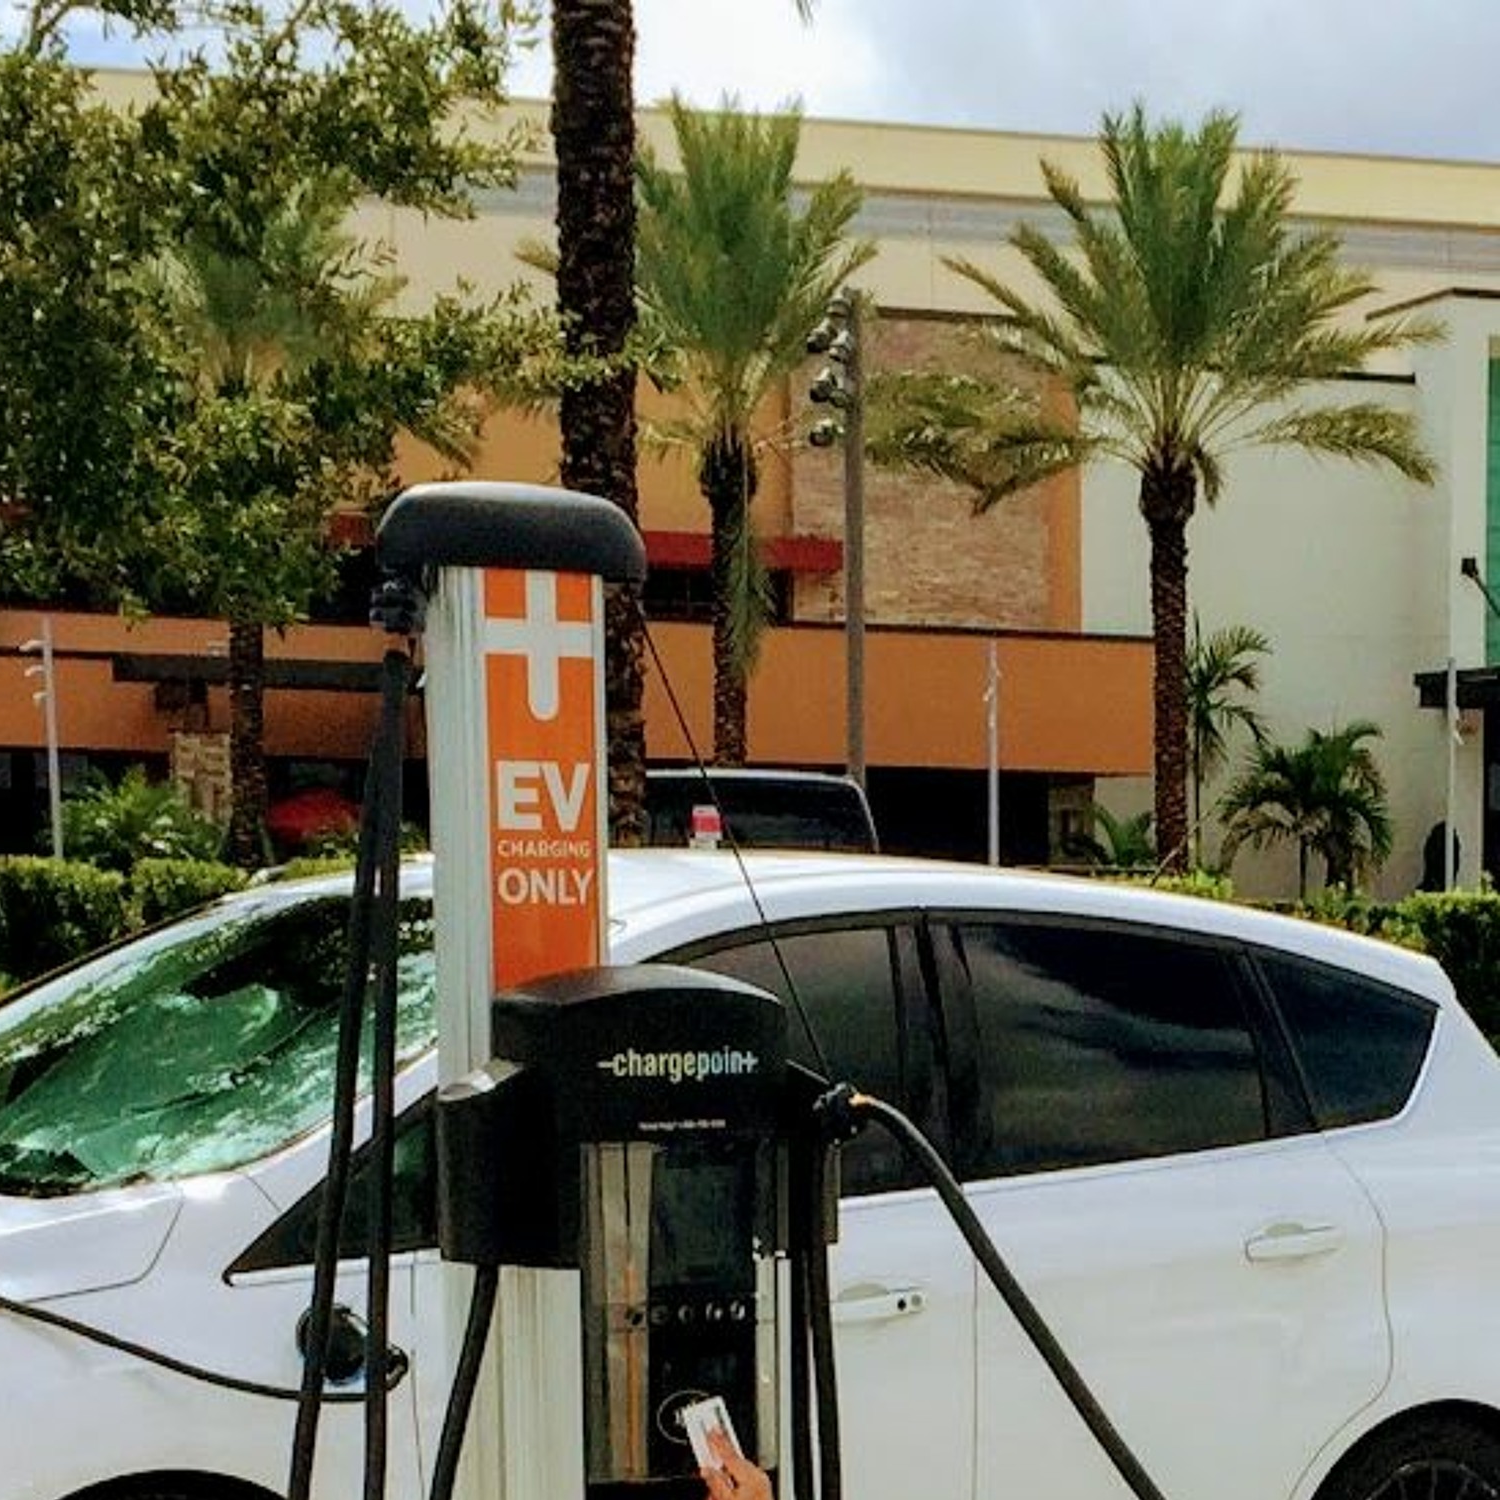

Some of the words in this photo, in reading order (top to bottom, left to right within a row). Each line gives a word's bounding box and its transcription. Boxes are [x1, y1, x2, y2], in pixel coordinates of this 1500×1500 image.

[495, 760, 591, 833] EV
[497, 839, 590, 858] CHARGING
[498, 867, 594, 905] ONLY
